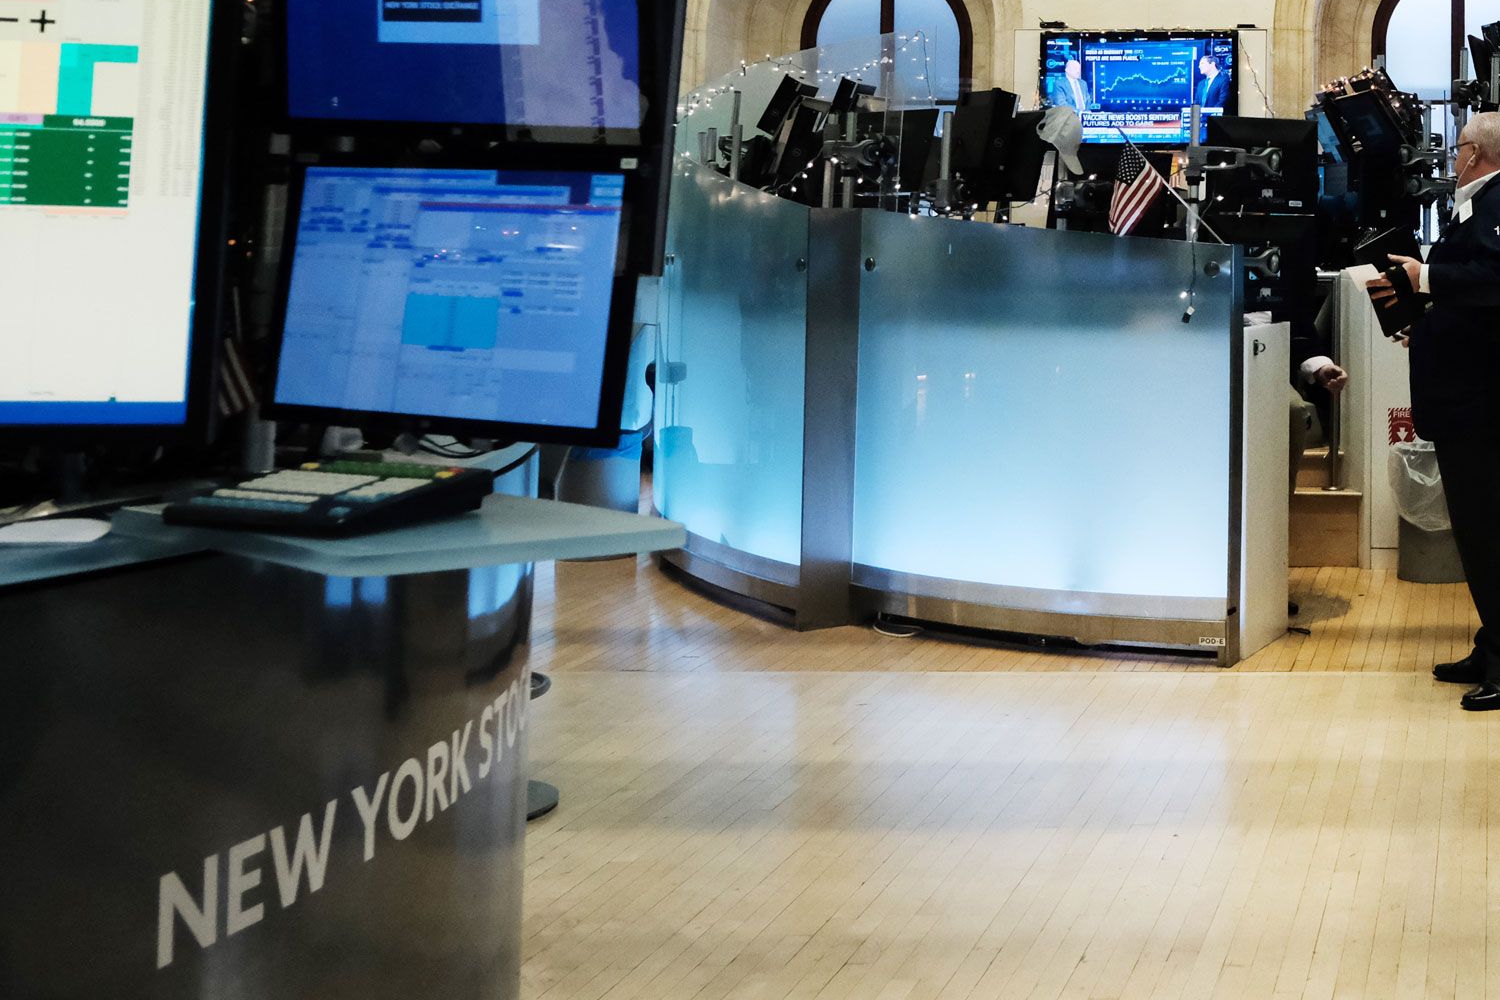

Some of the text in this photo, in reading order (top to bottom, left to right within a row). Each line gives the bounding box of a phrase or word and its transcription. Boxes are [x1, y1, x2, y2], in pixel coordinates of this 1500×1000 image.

[1201, 637, 1224, 645] POD-E
[157, 799, 337, 970] NEW
[350, 719, 473, 863] YORK
